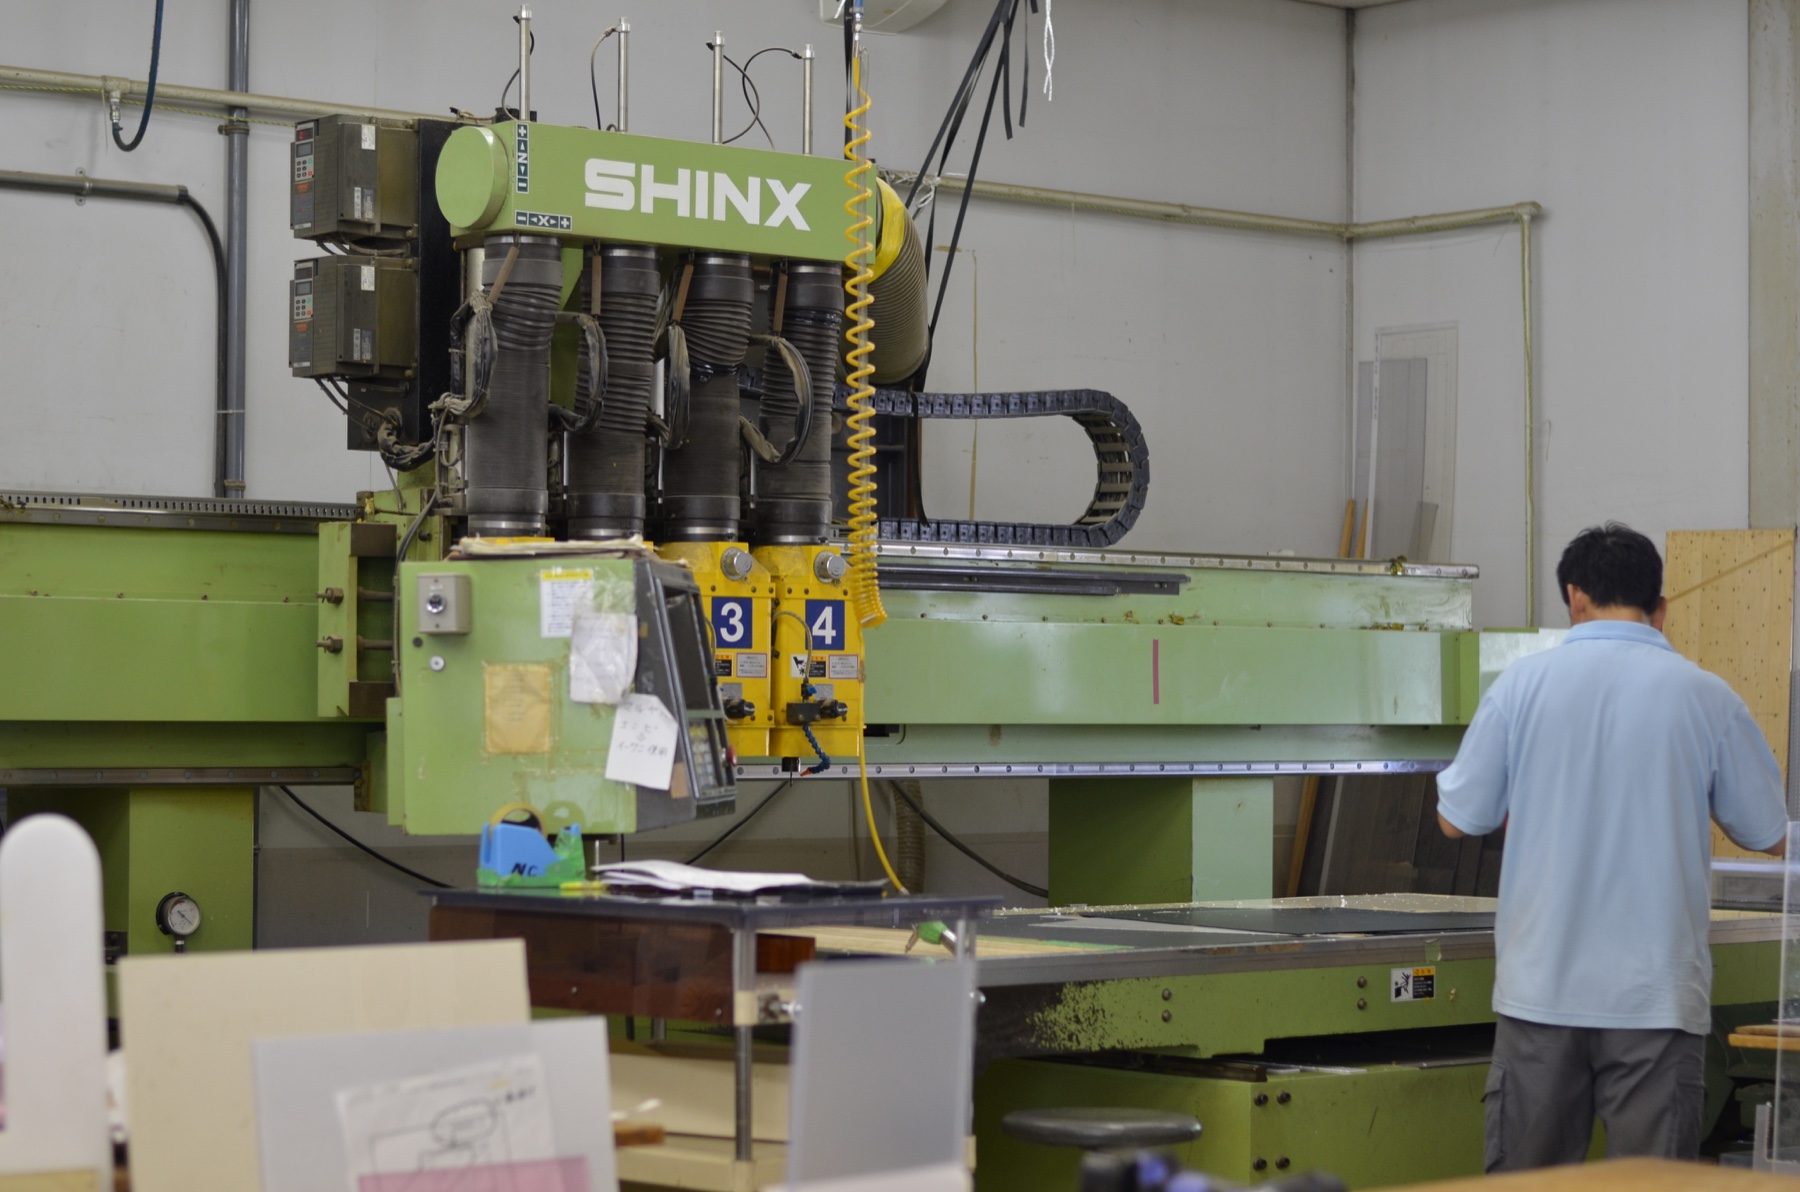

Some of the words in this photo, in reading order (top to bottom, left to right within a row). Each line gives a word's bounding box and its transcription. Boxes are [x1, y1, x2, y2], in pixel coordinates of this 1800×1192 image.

[585, 158, 812, 232] SHINX
[538, 215, 550, 227] X
[720, 602, 744, 643] 3
[812, 606, 837, 645] 4
[511, 862, 538, 877] NC
